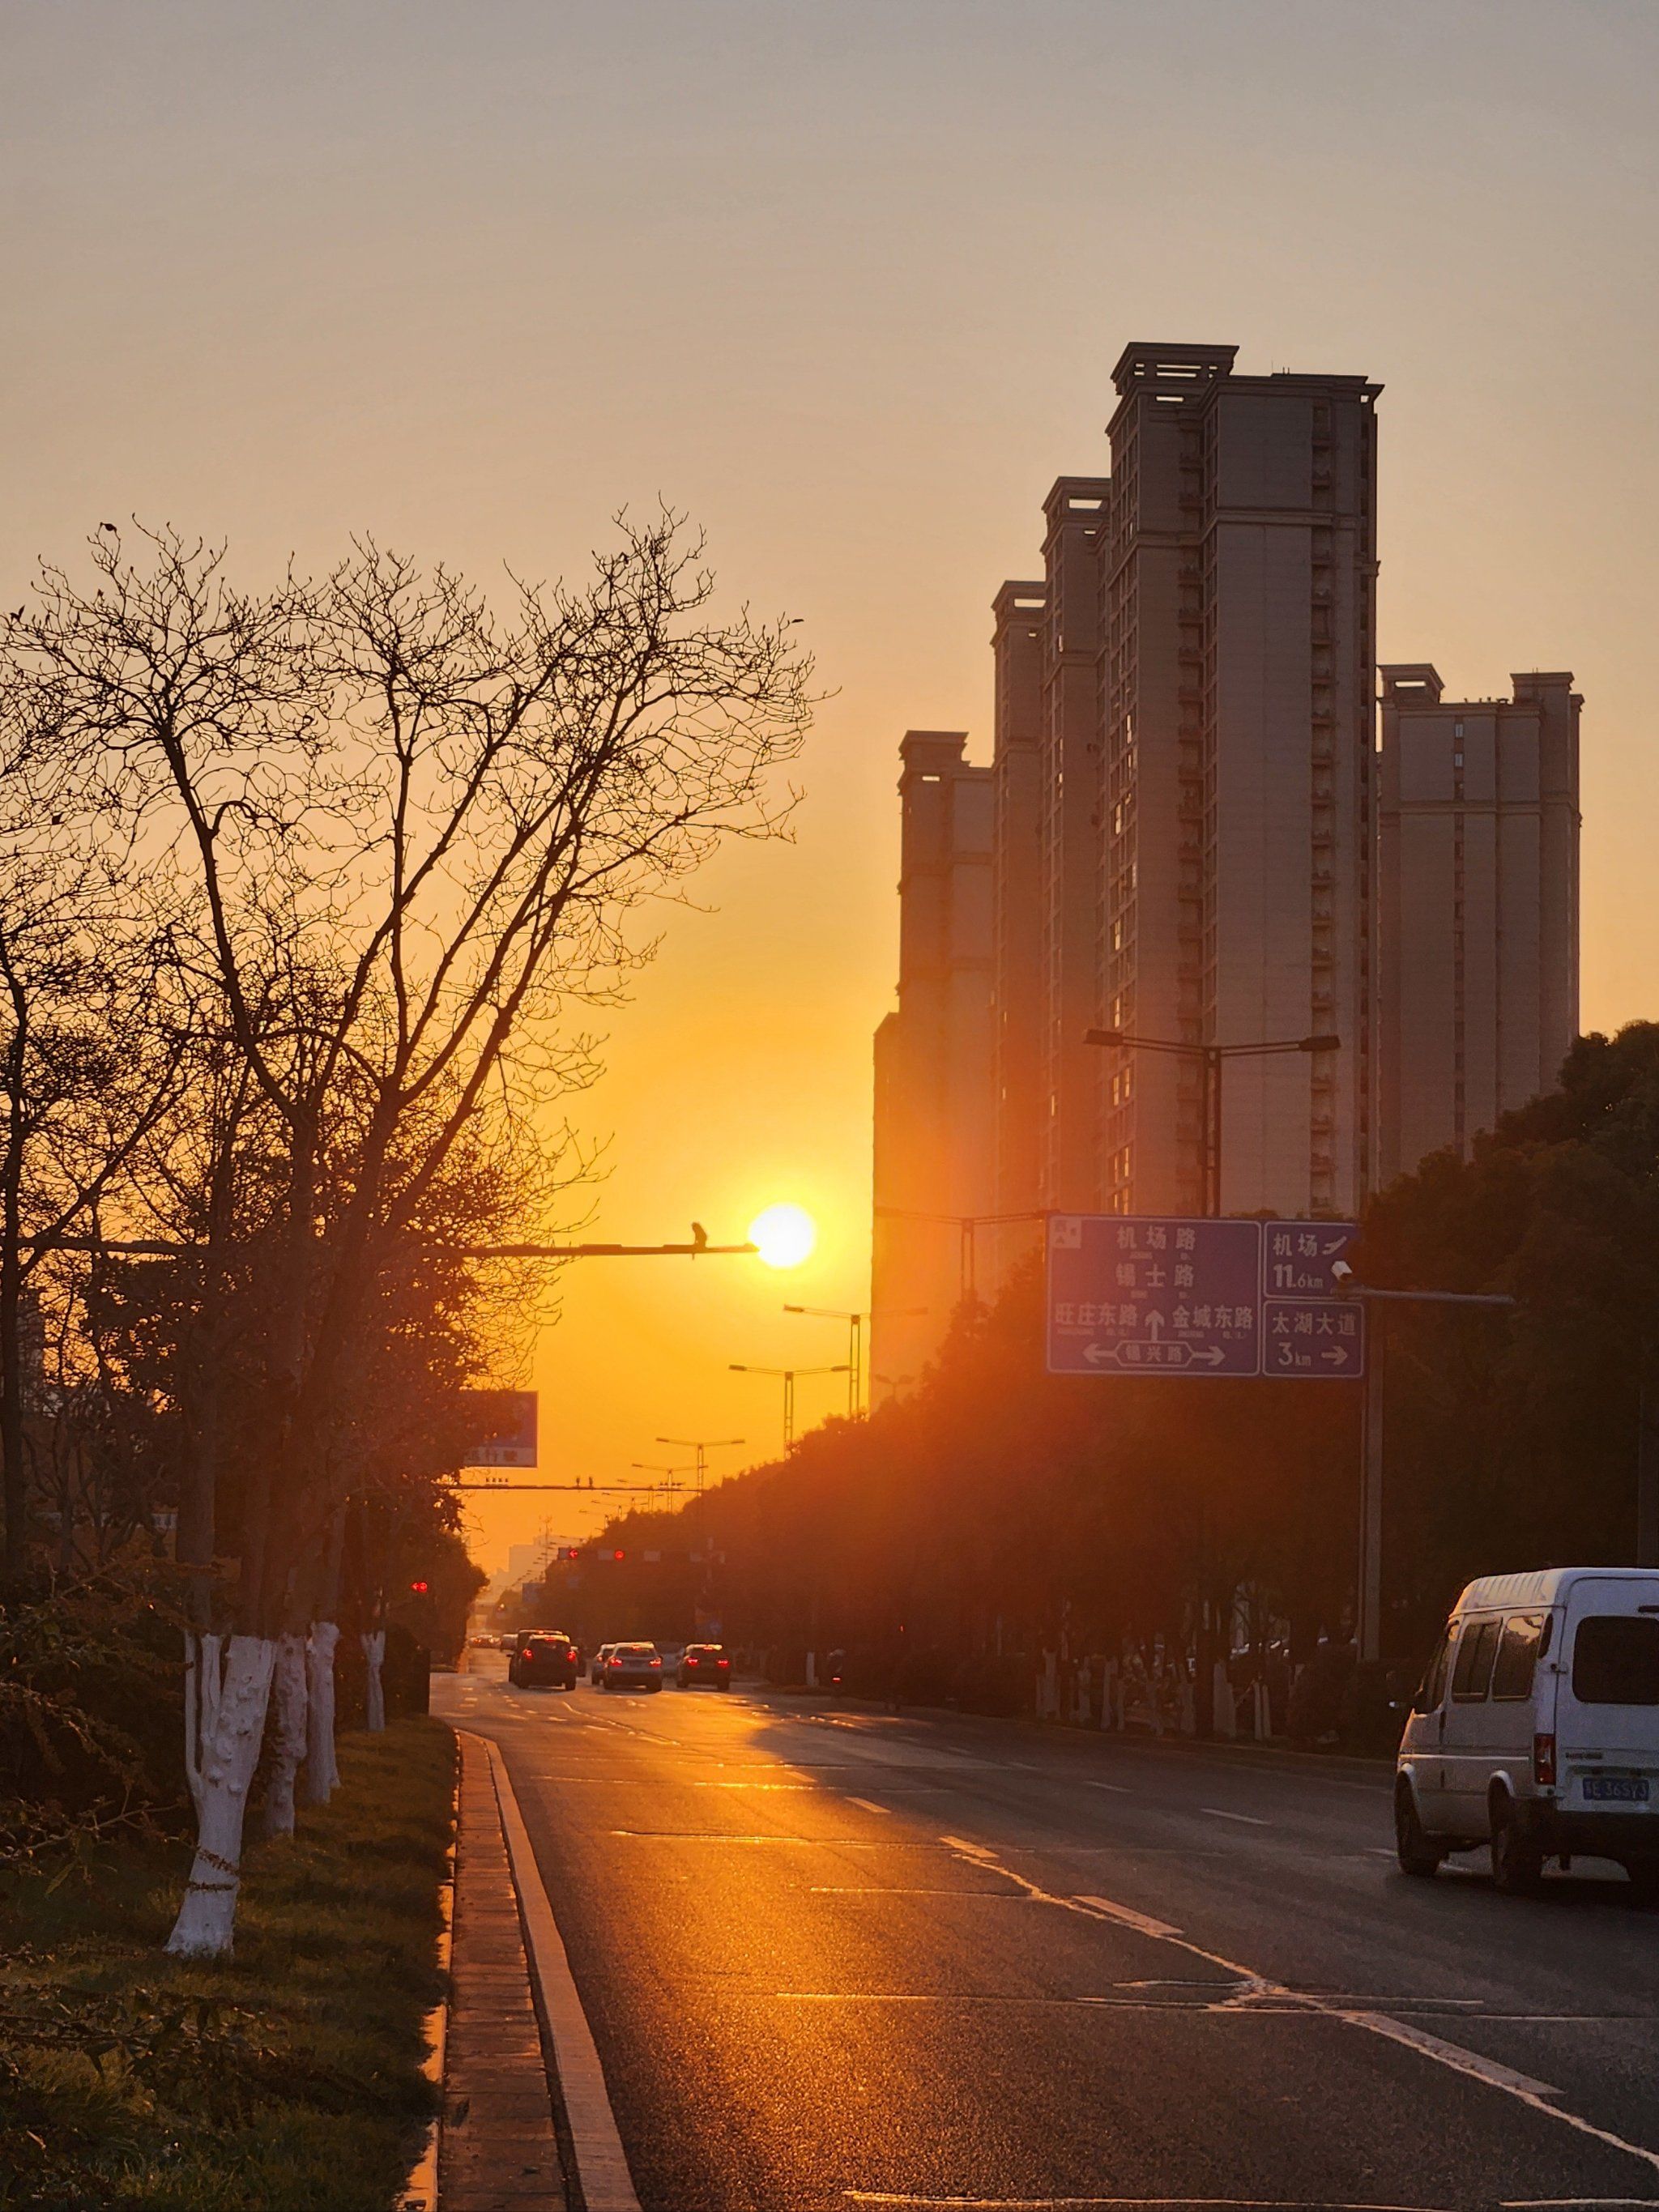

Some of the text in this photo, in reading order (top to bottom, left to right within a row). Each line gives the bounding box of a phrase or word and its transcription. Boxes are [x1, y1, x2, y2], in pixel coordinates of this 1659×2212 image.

[1116, 1225, 1196, 1251] 机场路
[1273, 1233, 1318, 1256] 机场
[1171, 1304, 1253, 1329] 金城东路
[1272, 1311, 1355, 1336] 太湖大道
